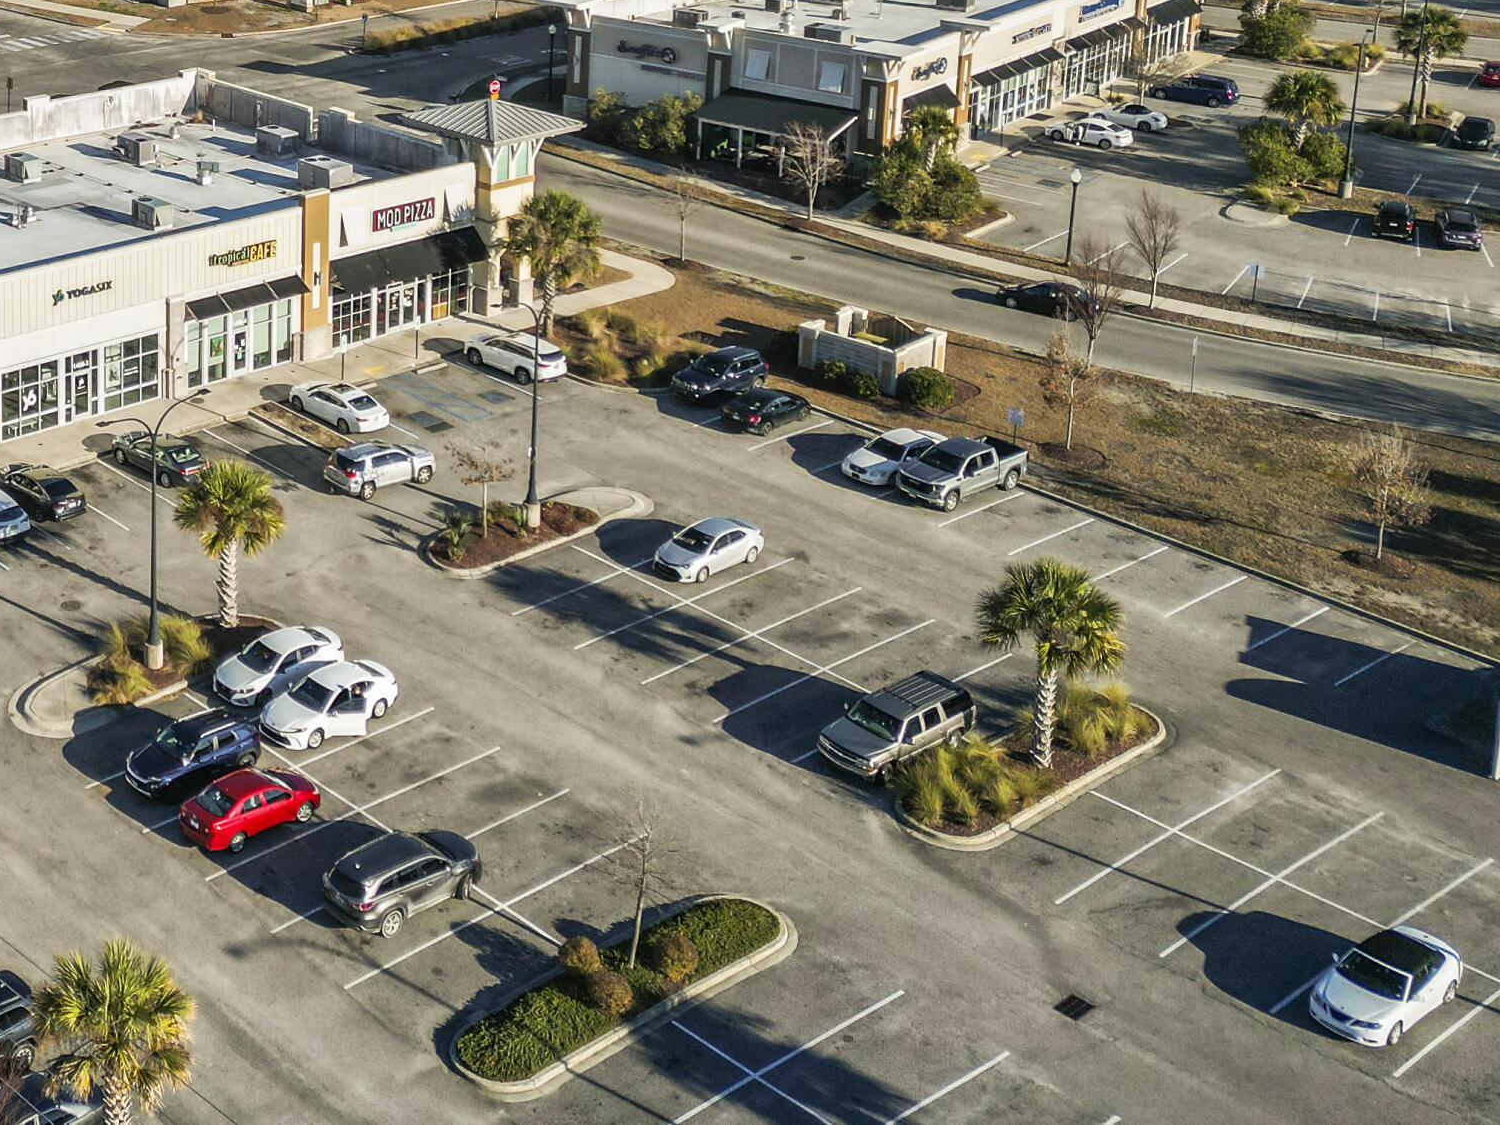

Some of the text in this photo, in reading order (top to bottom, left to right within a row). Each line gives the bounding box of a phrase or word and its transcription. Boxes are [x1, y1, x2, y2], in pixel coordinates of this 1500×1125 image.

[377, 200, 434, 230] MOD PIZZA
[250, 240, 277, 262] CAFE
[66, 280, 113, 299] YOGASIX
